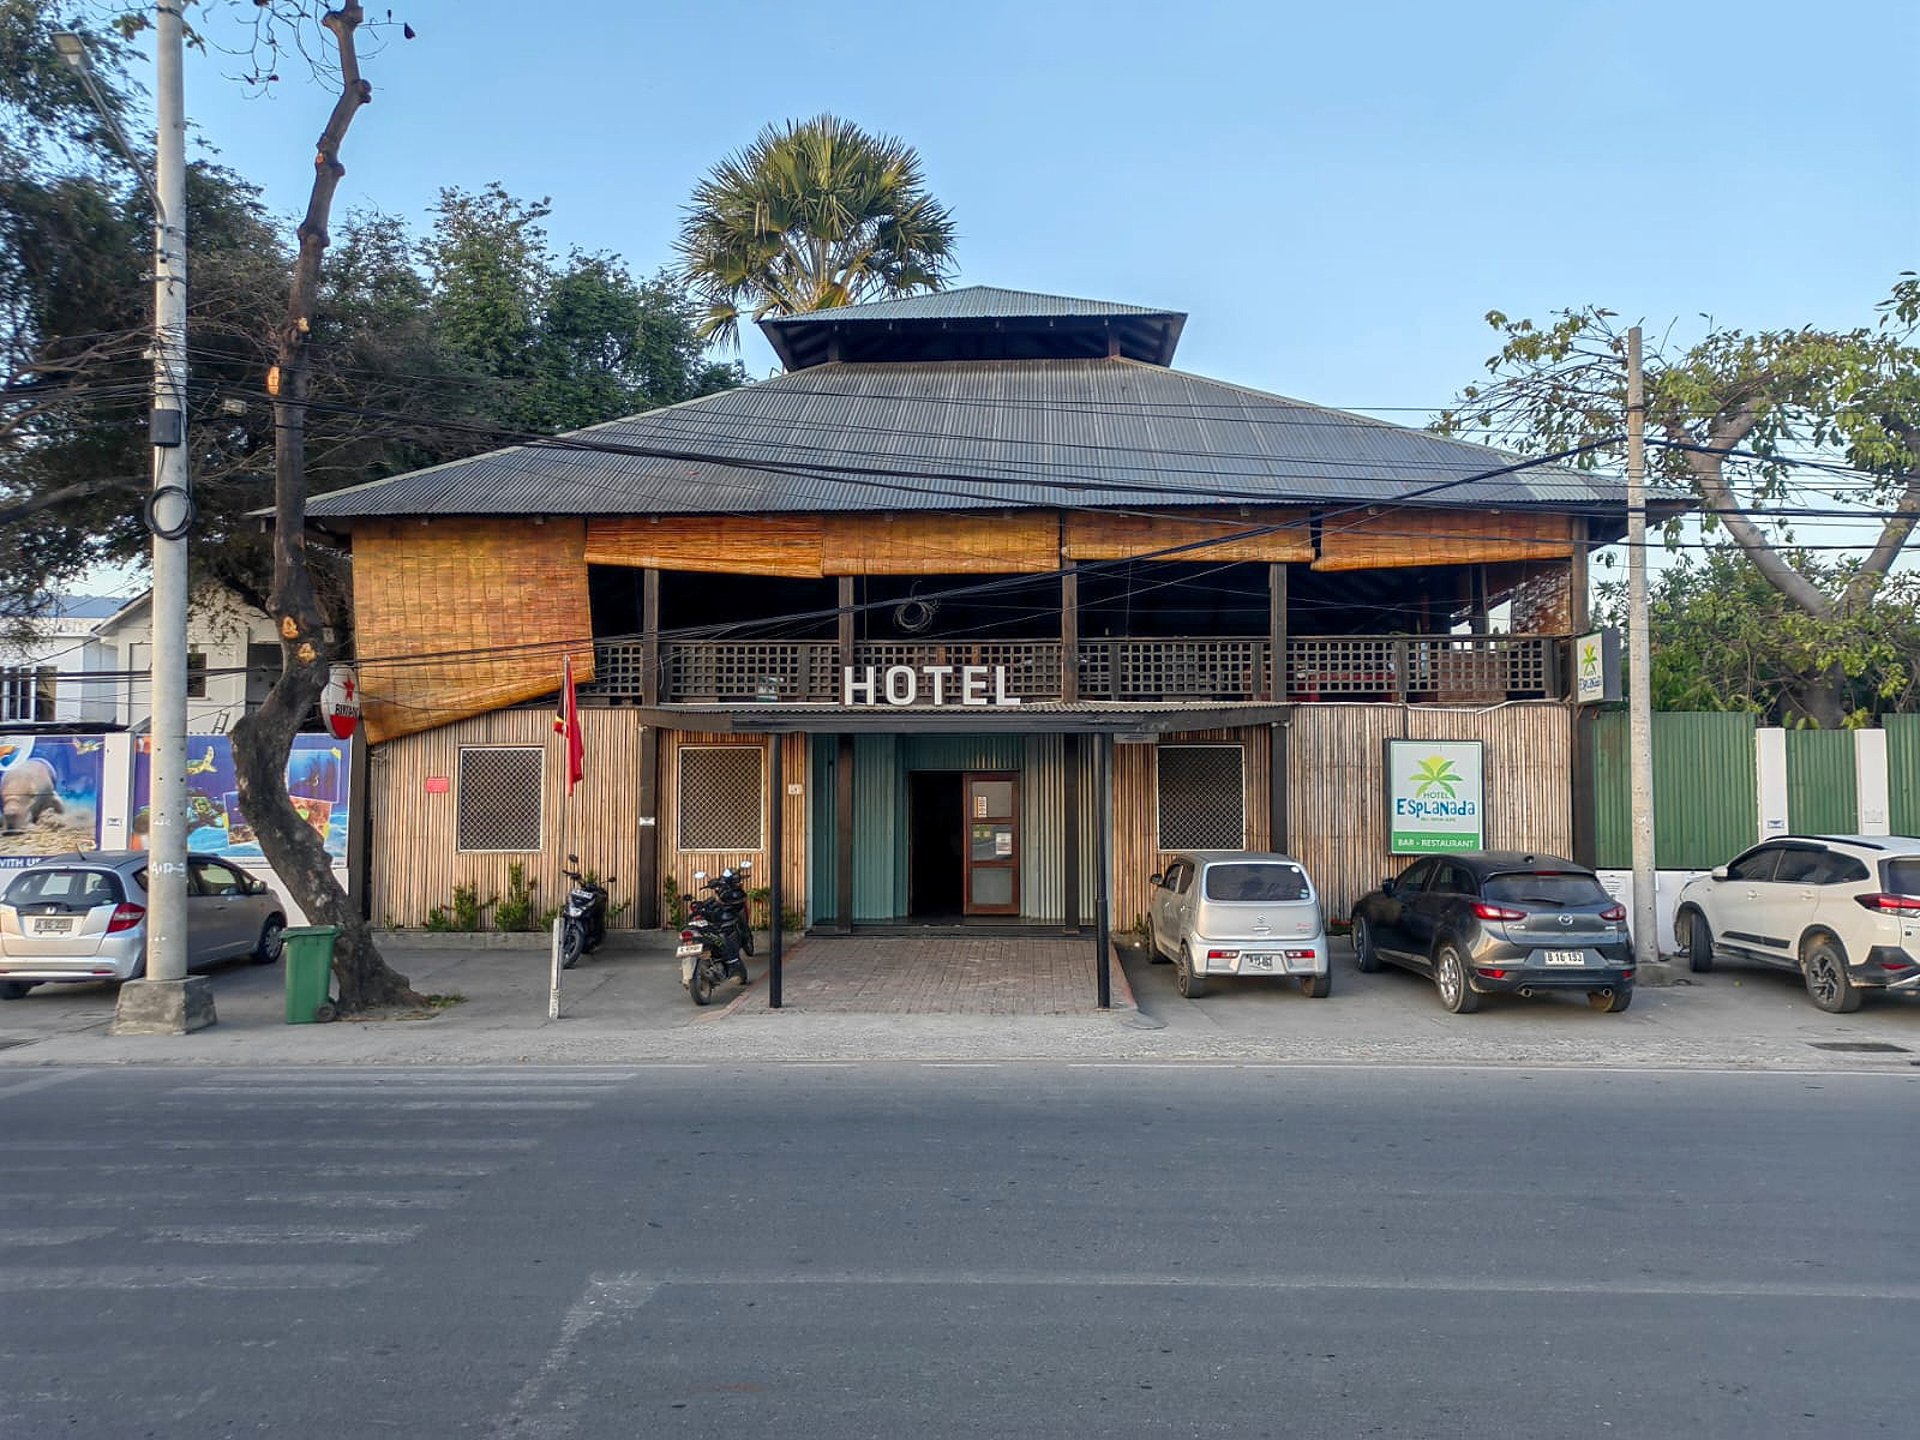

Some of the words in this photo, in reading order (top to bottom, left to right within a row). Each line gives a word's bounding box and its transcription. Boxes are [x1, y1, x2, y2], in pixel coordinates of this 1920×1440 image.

[844, 665, 1021, 706] HOTEL
[1423, 791, 1450, 799] HOTEL
[1398, 838, 1415, 847] BAR
[1421, 838, 1474, 848] RESTAURANT
